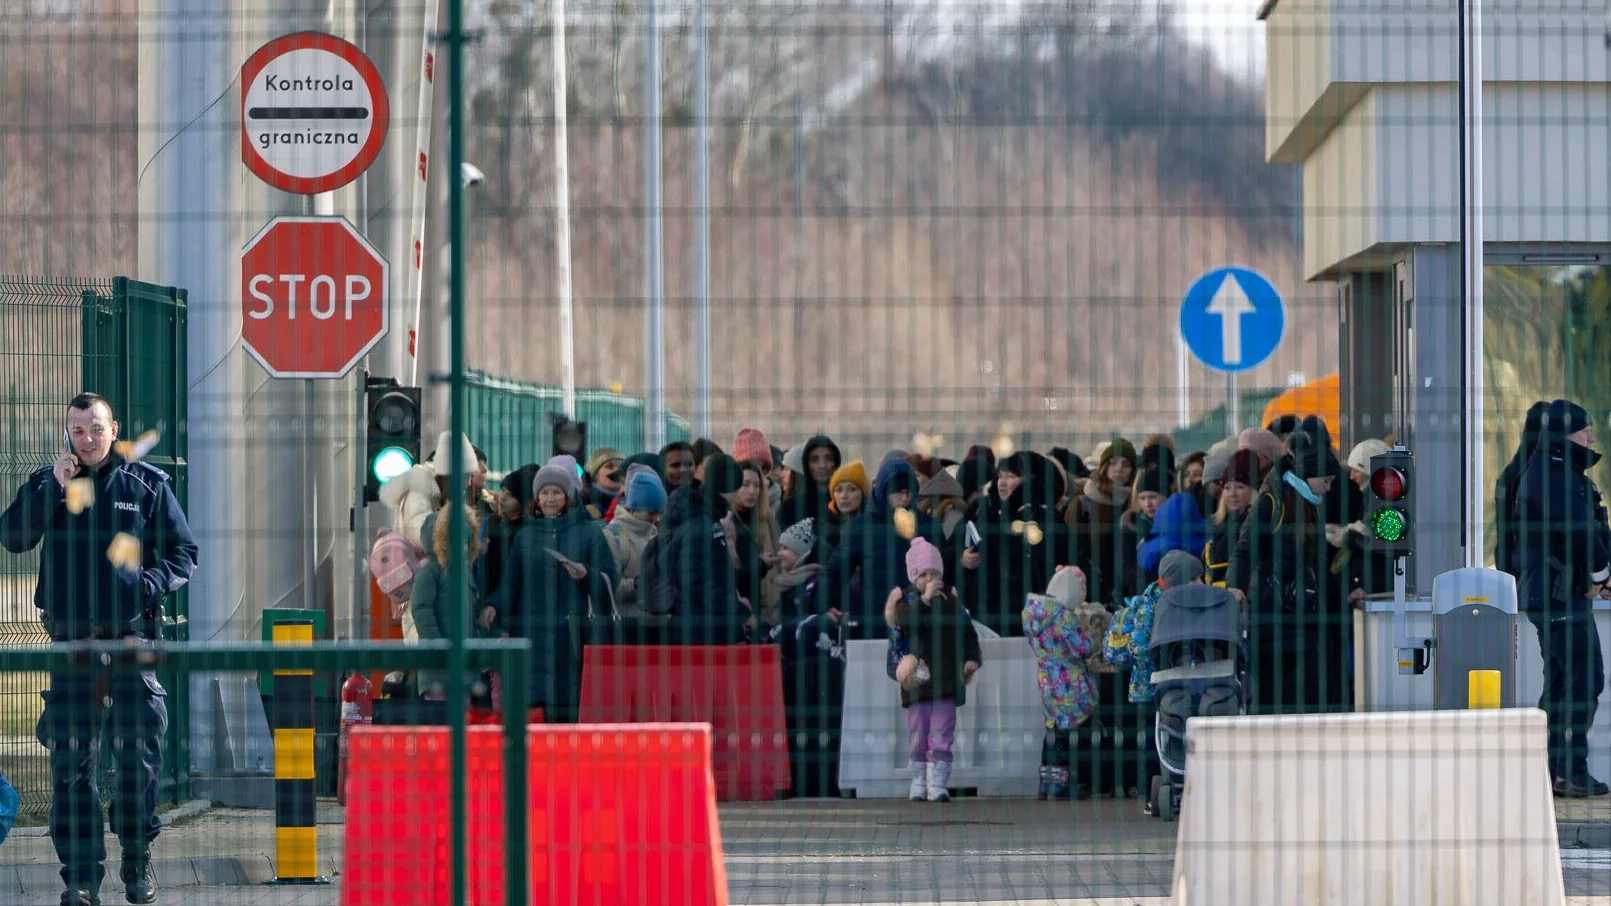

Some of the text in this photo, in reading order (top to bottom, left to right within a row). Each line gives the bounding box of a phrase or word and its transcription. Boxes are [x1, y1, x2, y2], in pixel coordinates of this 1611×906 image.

[265, 75, 353, 91] Kontrola
[259, 128, 358, 149] graniczna
[249, 274, 371, 320] STOP
[114, 502, 140, 512] POLICJA
